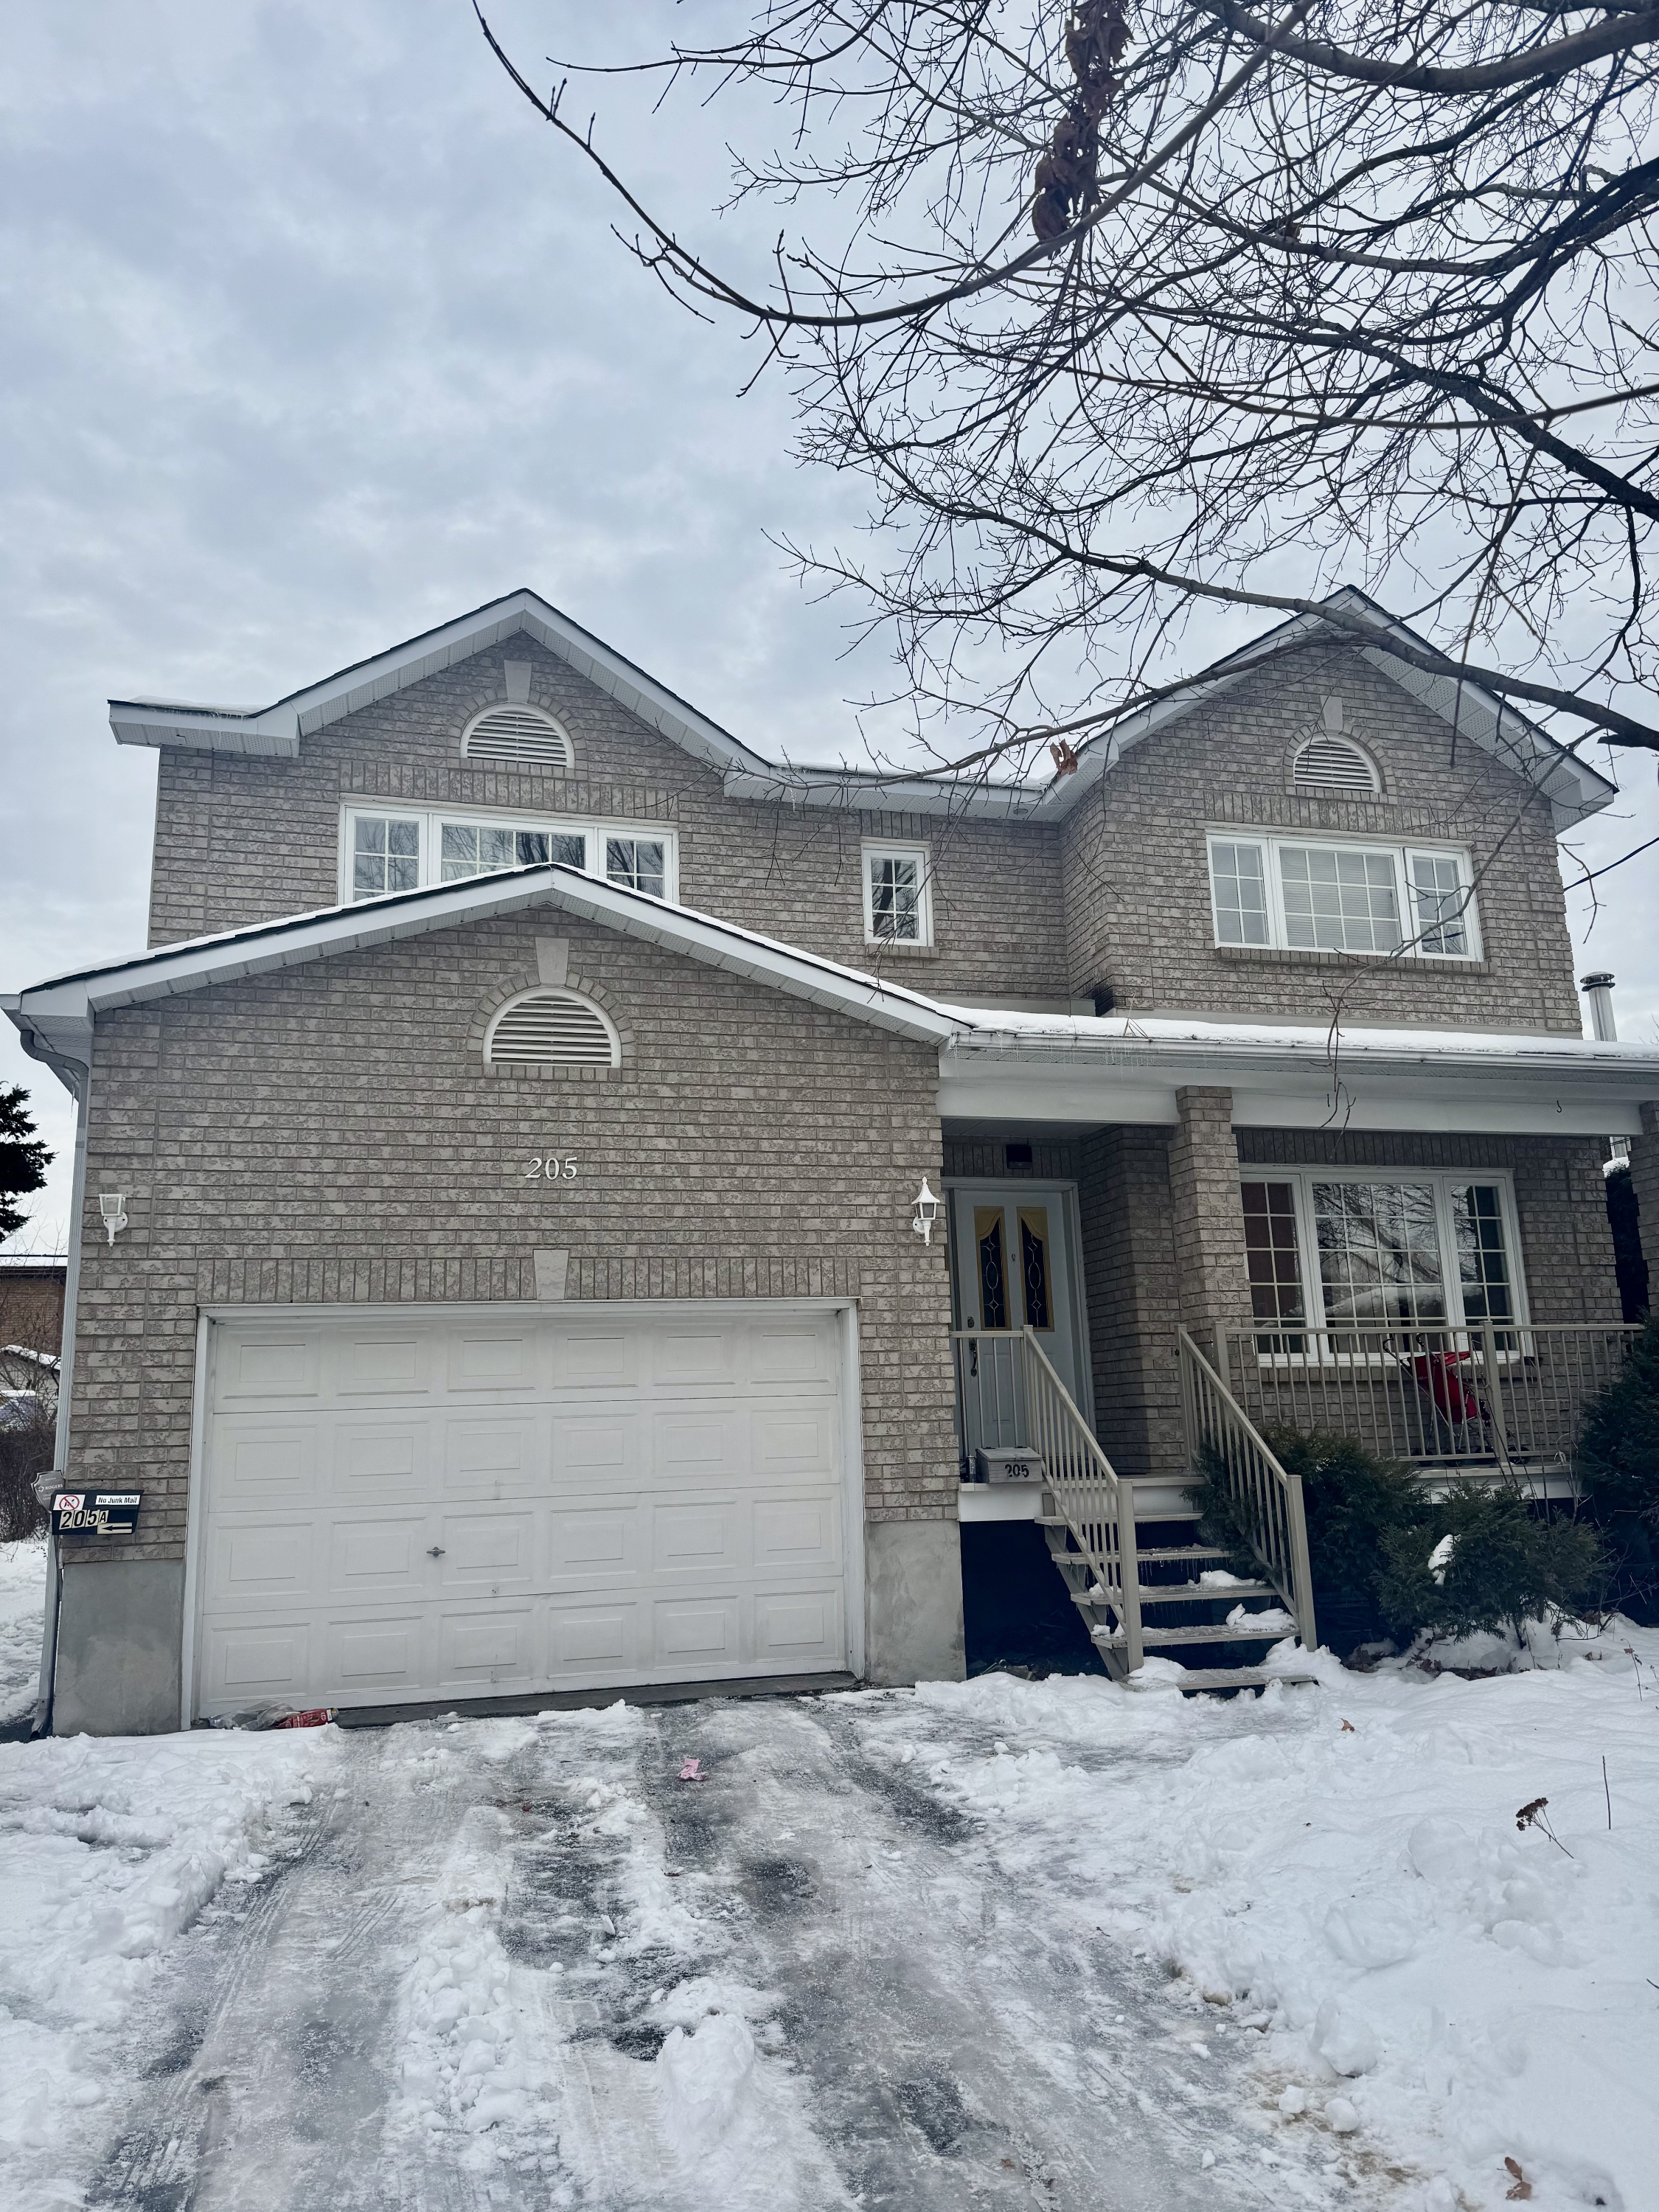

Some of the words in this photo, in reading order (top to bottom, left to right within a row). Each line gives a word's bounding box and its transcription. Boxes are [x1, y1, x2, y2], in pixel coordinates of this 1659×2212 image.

[524, 1156, 577, 1180] 205
[1004, 1464, 1029, 1478] 205
[60, 1510, 106, 1528] 205A
